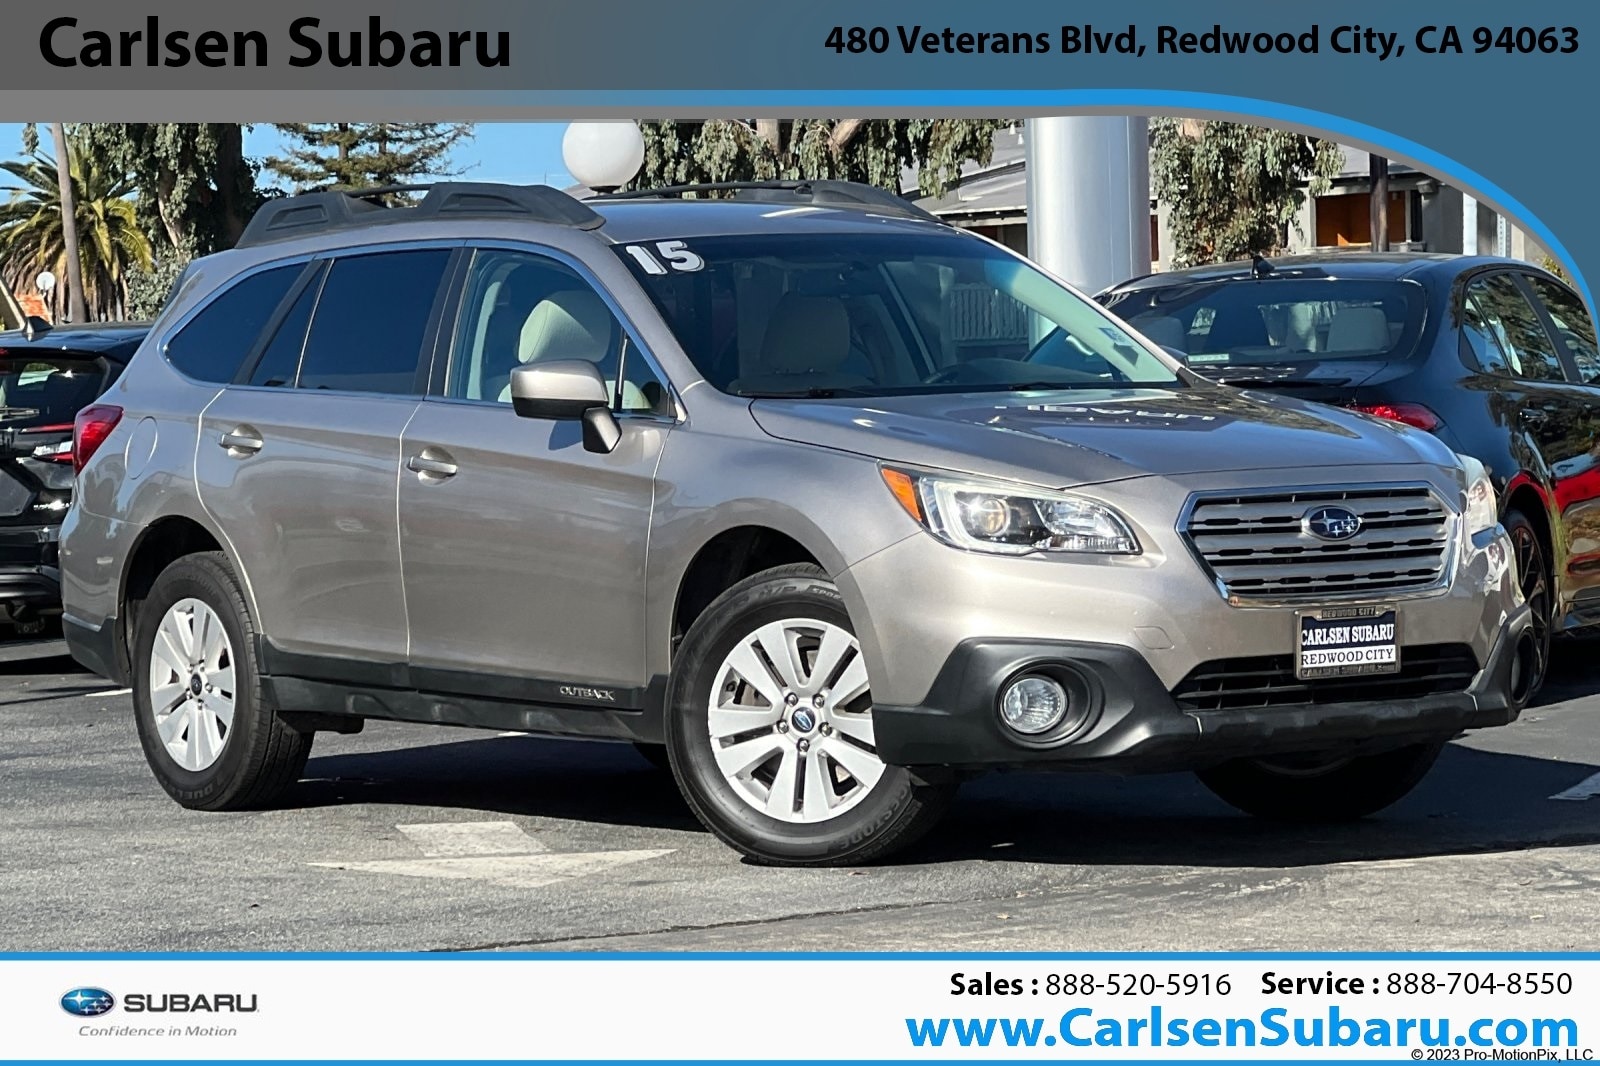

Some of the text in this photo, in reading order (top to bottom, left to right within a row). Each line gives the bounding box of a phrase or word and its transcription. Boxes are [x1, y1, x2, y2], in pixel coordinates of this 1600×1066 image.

[626, 241, 705, 275] 15
[1358, 606, 1375, 617] CITY
[1301, 623, 1395, 646] CARLSEN SUBARU
[1301, 648, 1394, 666] REDWOOD CITY
[560, 686, 615, 701] OUTBACK
